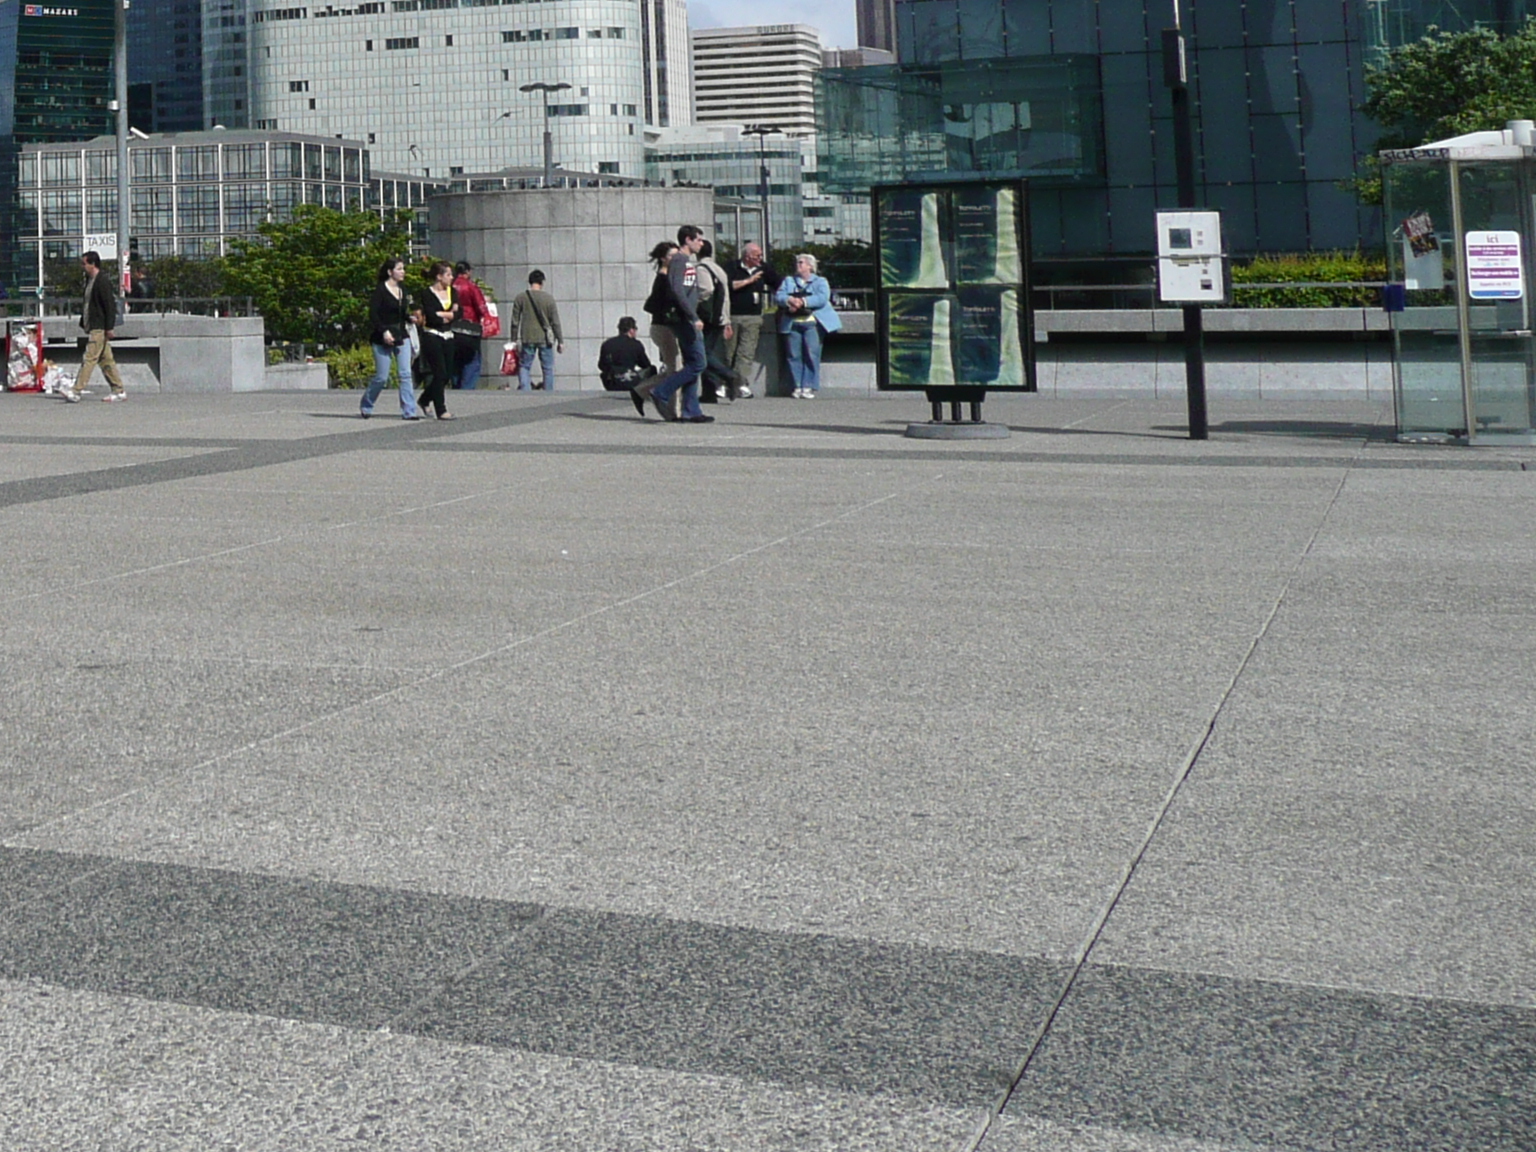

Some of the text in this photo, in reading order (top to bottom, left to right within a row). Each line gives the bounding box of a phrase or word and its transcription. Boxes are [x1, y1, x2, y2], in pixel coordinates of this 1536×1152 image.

[43, 7, 78, 16] MAZARS
[86, 235, 116, 247] TAXIS
[1486, 234, 1499, 244] ici
